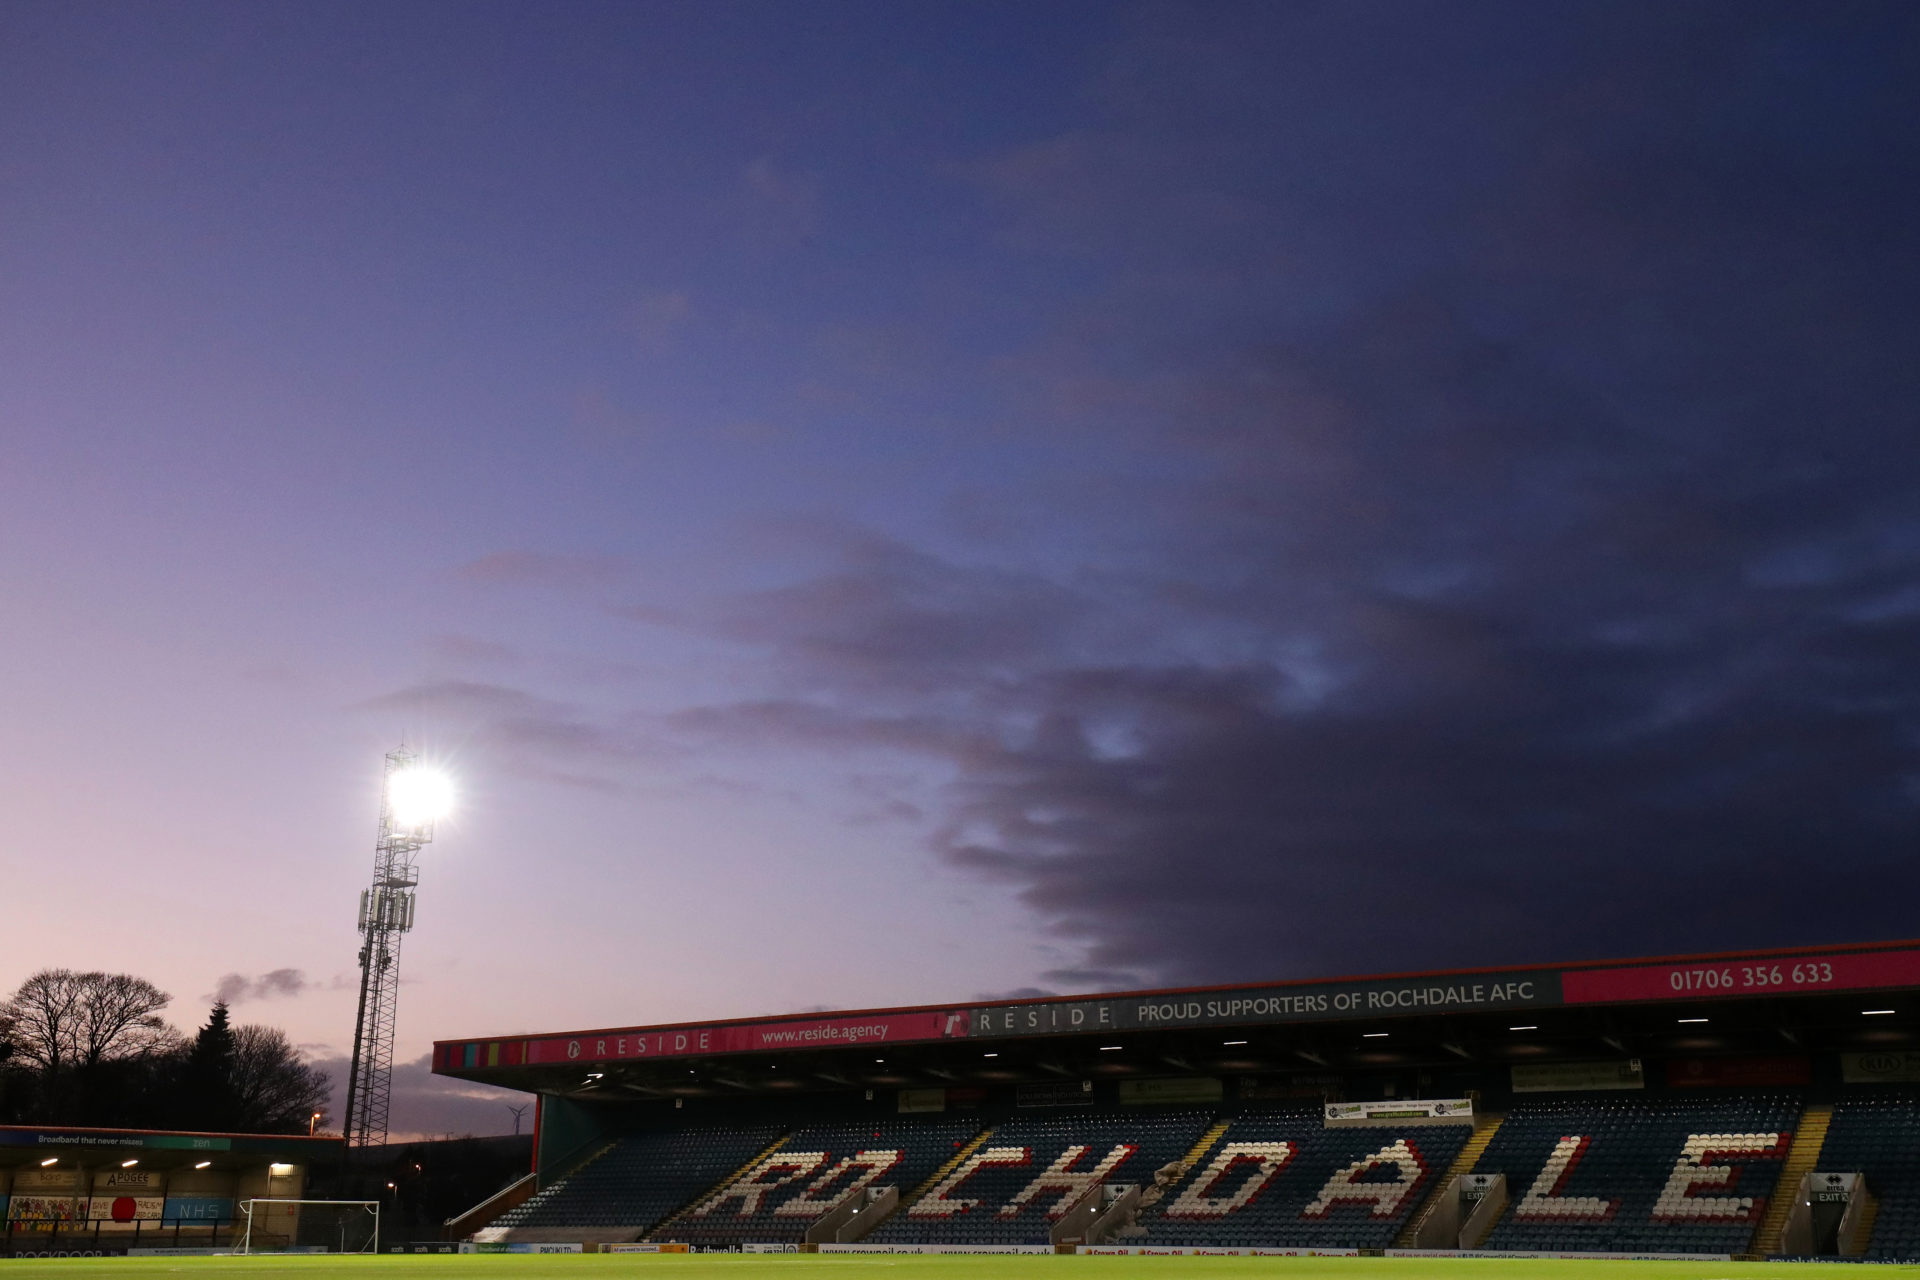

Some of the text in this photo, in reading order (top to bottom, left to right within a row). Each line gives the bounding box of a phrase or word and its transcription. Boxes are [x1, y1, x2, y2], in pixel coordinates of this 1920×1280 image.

[1670, 963, 1834, 992] 01706 356 633
[1138, 981, 1534, 1022] PROUD SUPPORTERS OF ROCHDALE AFC
[980, 1007, 1110, 1030] RESIDE
[761, 1022, 889, 1044] www.reside.agency
[597, 1032, 709, 1056] RESIDE
[38, 1134, 144, 1146] Broadband that never misses
[106, 1171, 149, 1186] APOGEE
[1466, 1192, 1485, 1200] EXIT
[1819, 1192, 1840, 1201] EXIT
[180, 1204, 219, 1219] NHS
